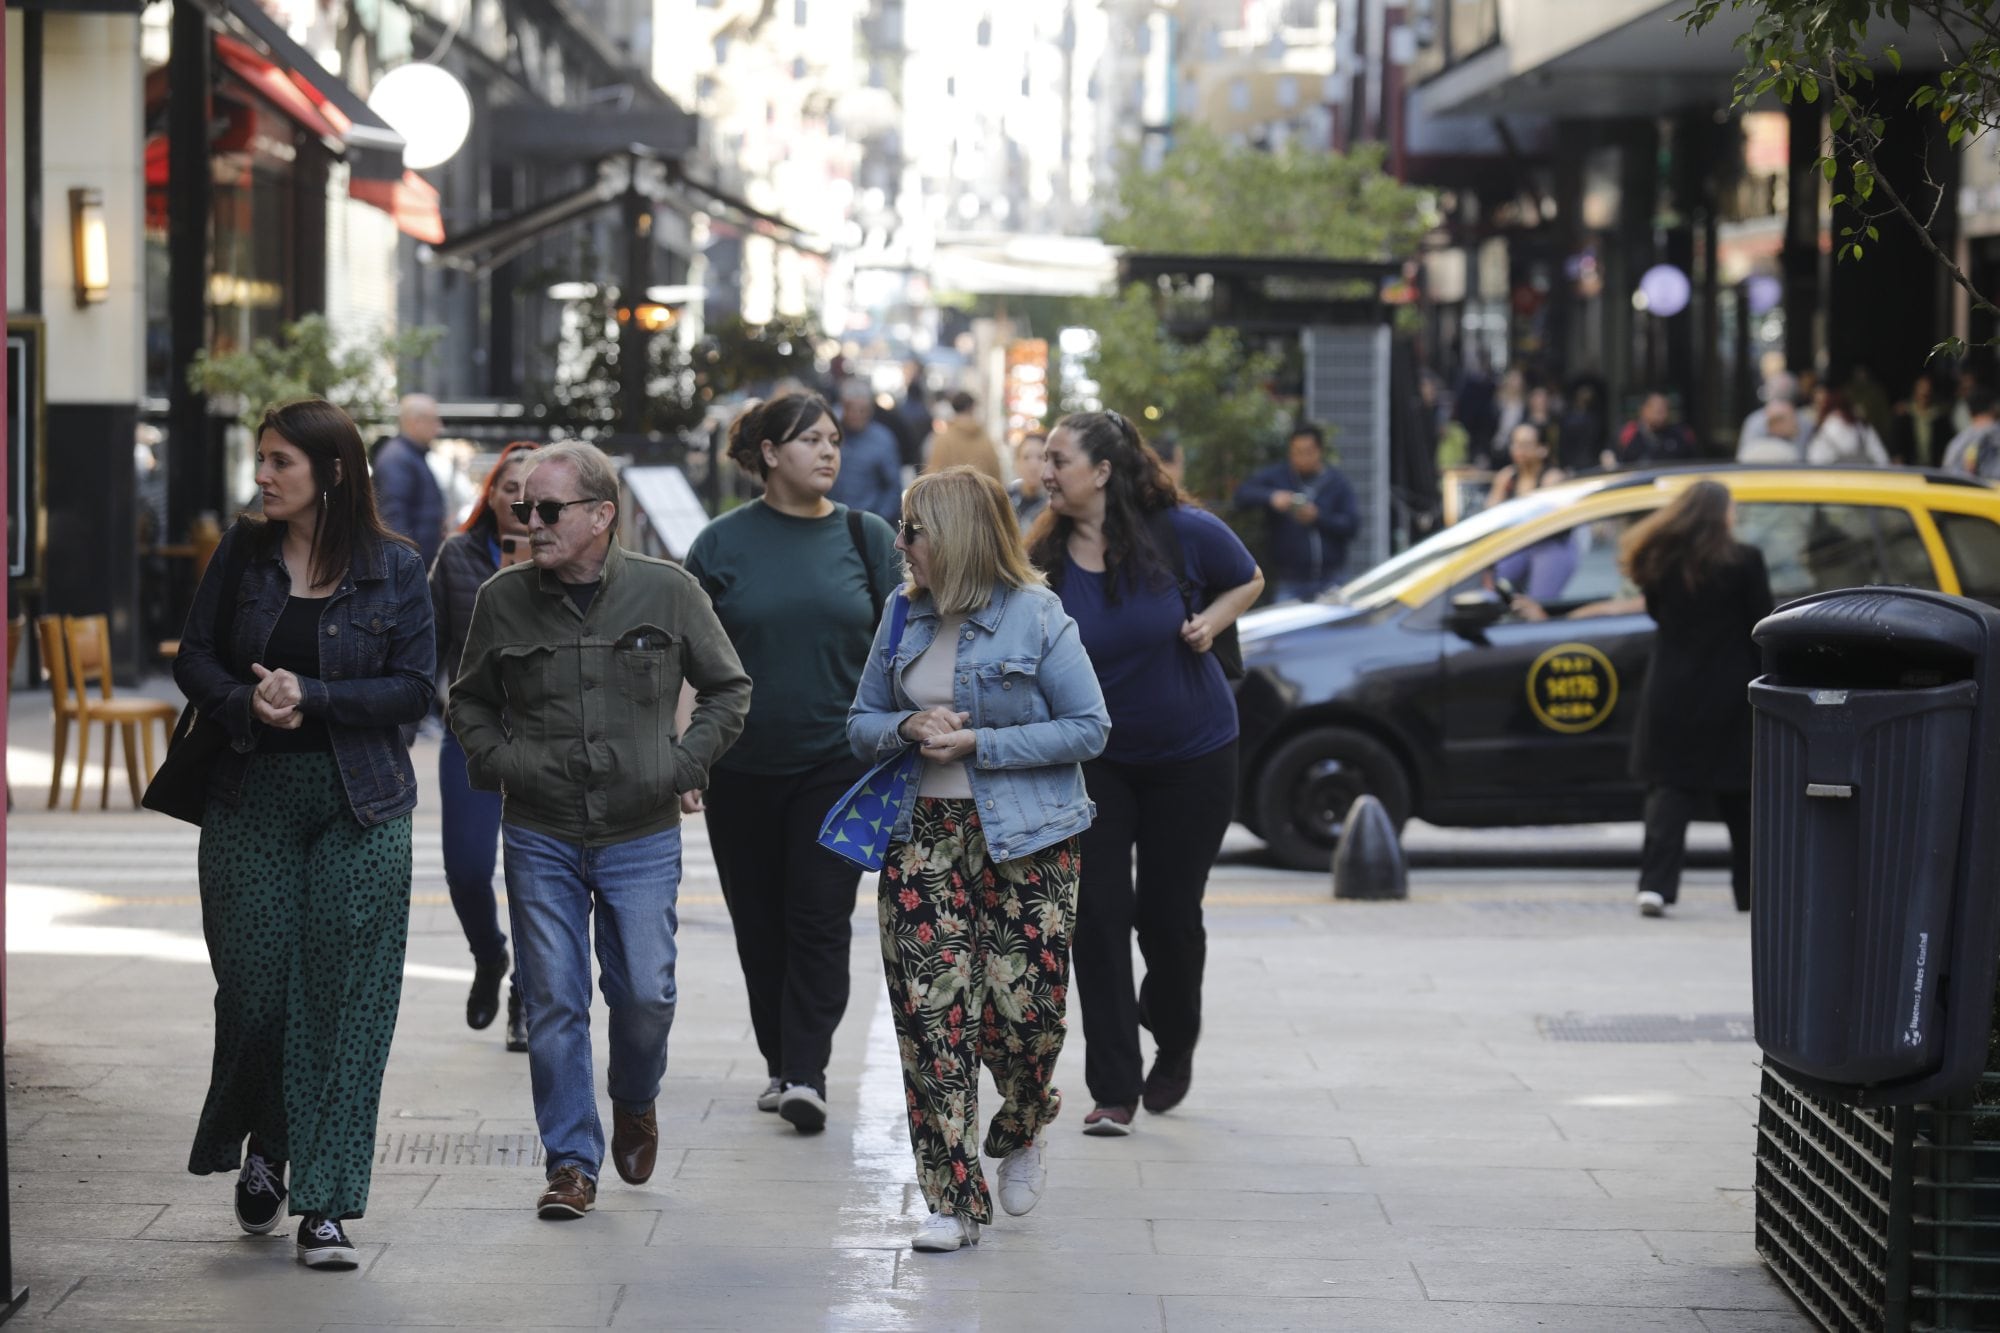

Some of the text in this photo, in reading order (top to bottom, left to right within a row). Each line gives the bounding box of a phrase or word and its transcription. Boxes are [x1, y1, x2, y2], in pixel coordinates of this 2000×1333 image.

[1551, 657, 1592, 672] TAXI
[1917, 933, 1928, 966] Ciudad
[1914, 968, 1924, 992] Aires
